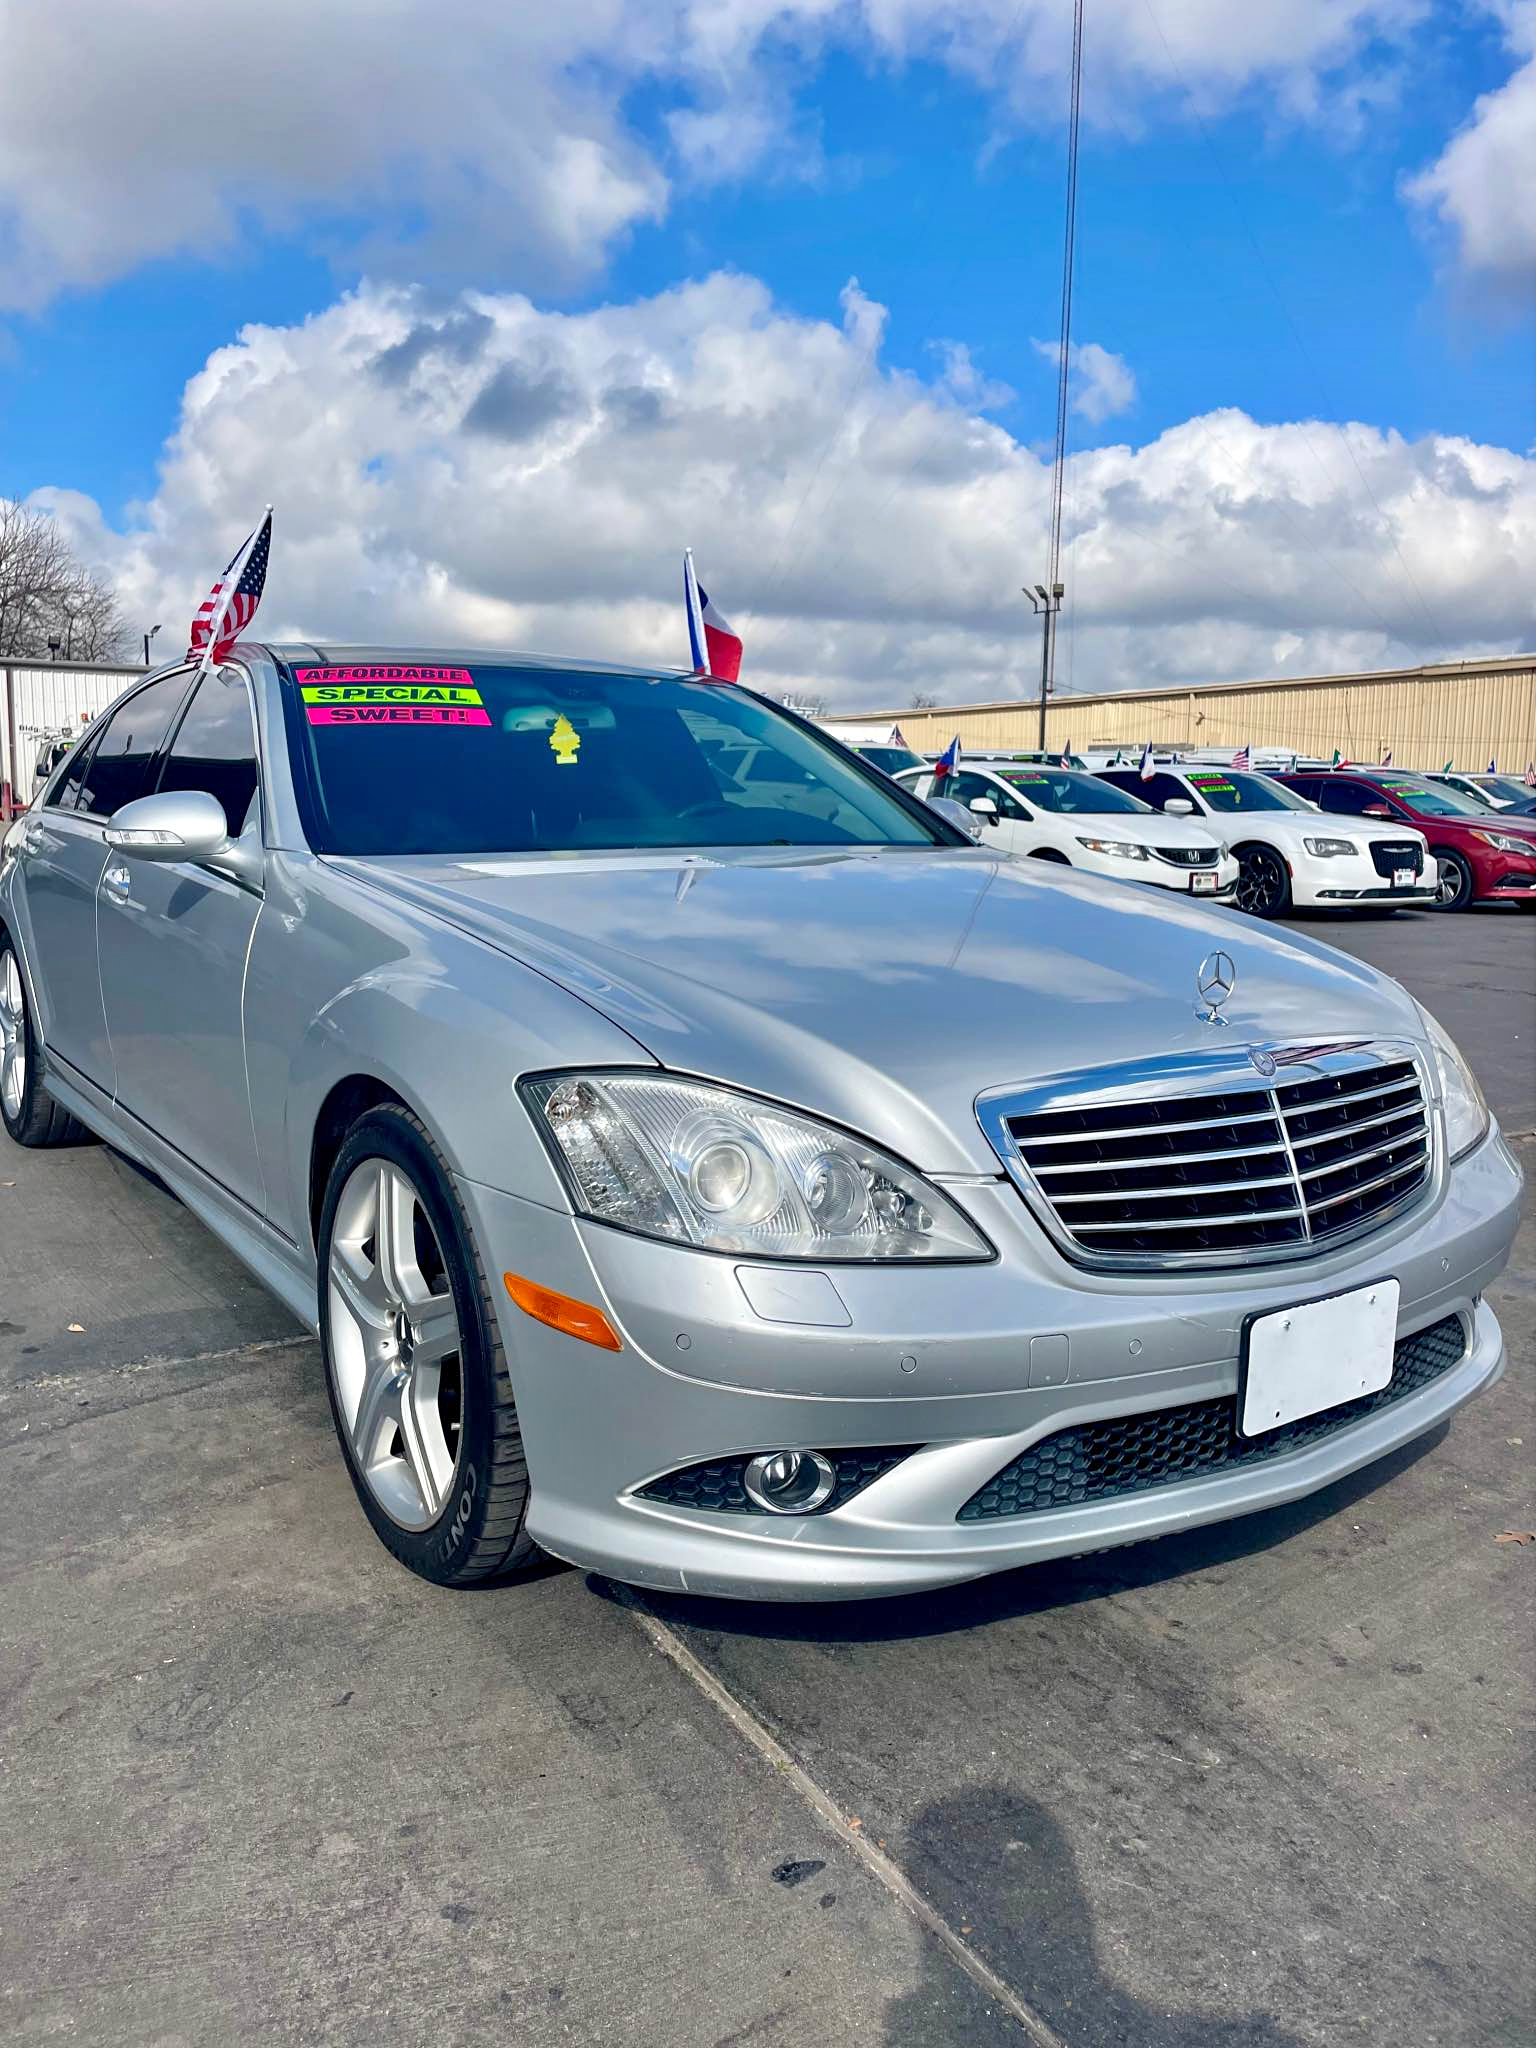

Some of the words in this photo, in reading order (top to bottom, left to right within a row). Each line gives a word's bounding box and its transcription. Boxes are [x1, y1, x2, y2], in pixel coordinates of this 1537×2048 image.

[304, 668, 464, 680] AFFORDABLE
[316, 688, 467, 701] SPECIAL
[330, 709, 467, 721] SWEET!
